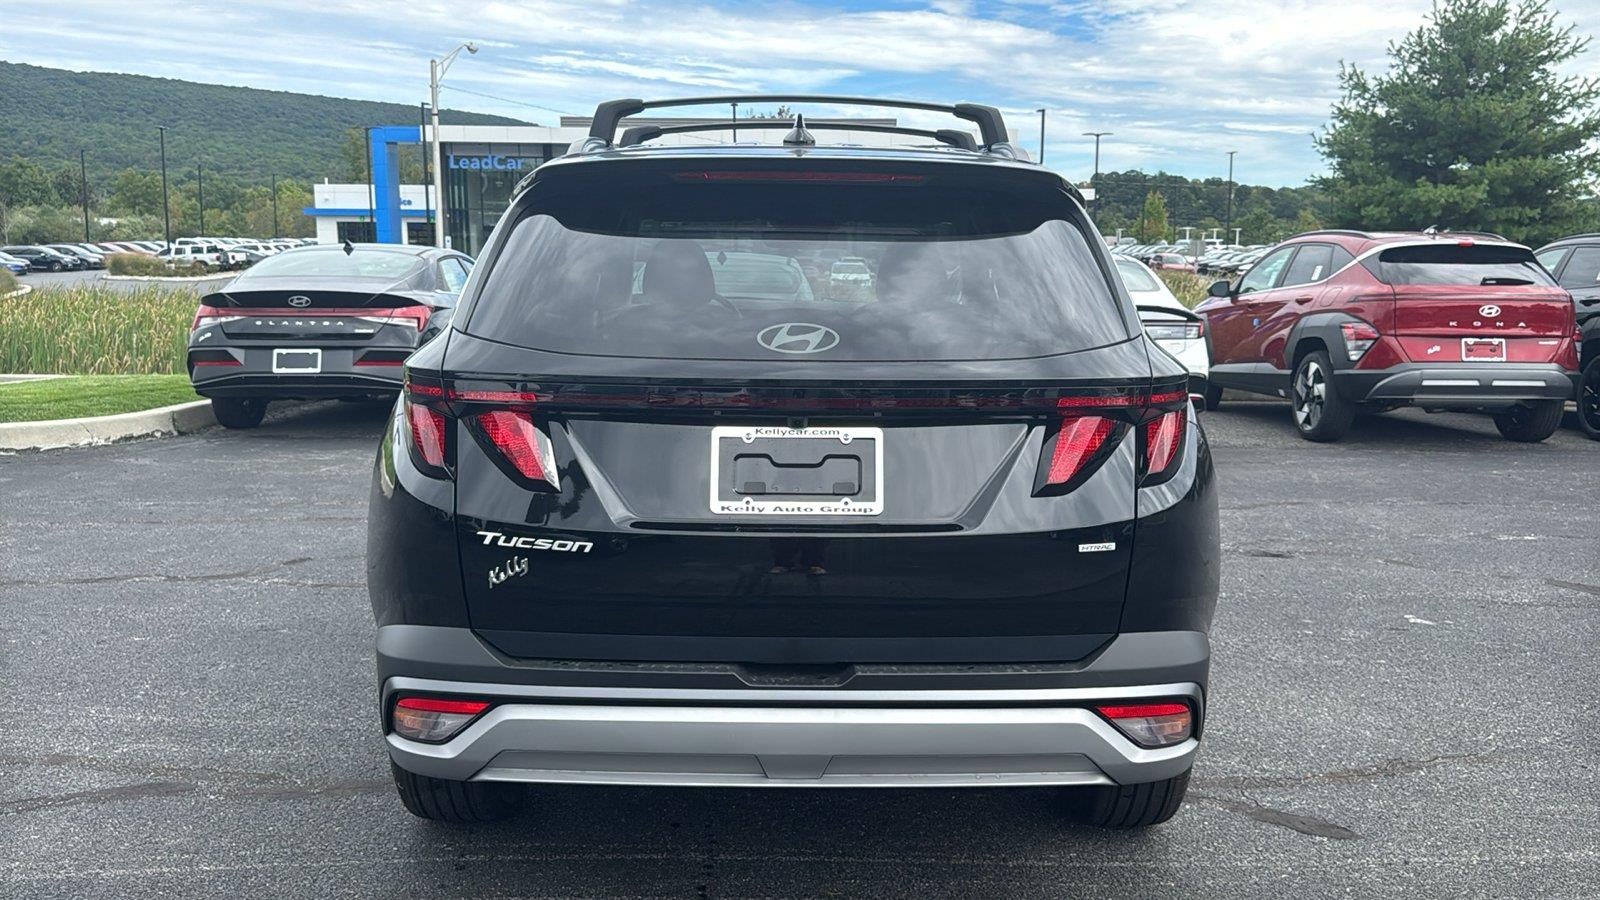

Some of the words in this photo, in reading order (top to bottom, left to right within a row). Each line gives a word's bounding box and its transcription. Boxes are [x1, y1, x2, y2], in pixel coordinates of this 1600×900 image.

[449, 154, 523, 170] LeadCar
[755, 428, 840, 436] Kellycar.com
[720, 505, 765, 513] Kelly
[772, 505, 814, 513] Auto
[819, 506, 874, 514] Group
[488, 555, 528, 589] Kelly
